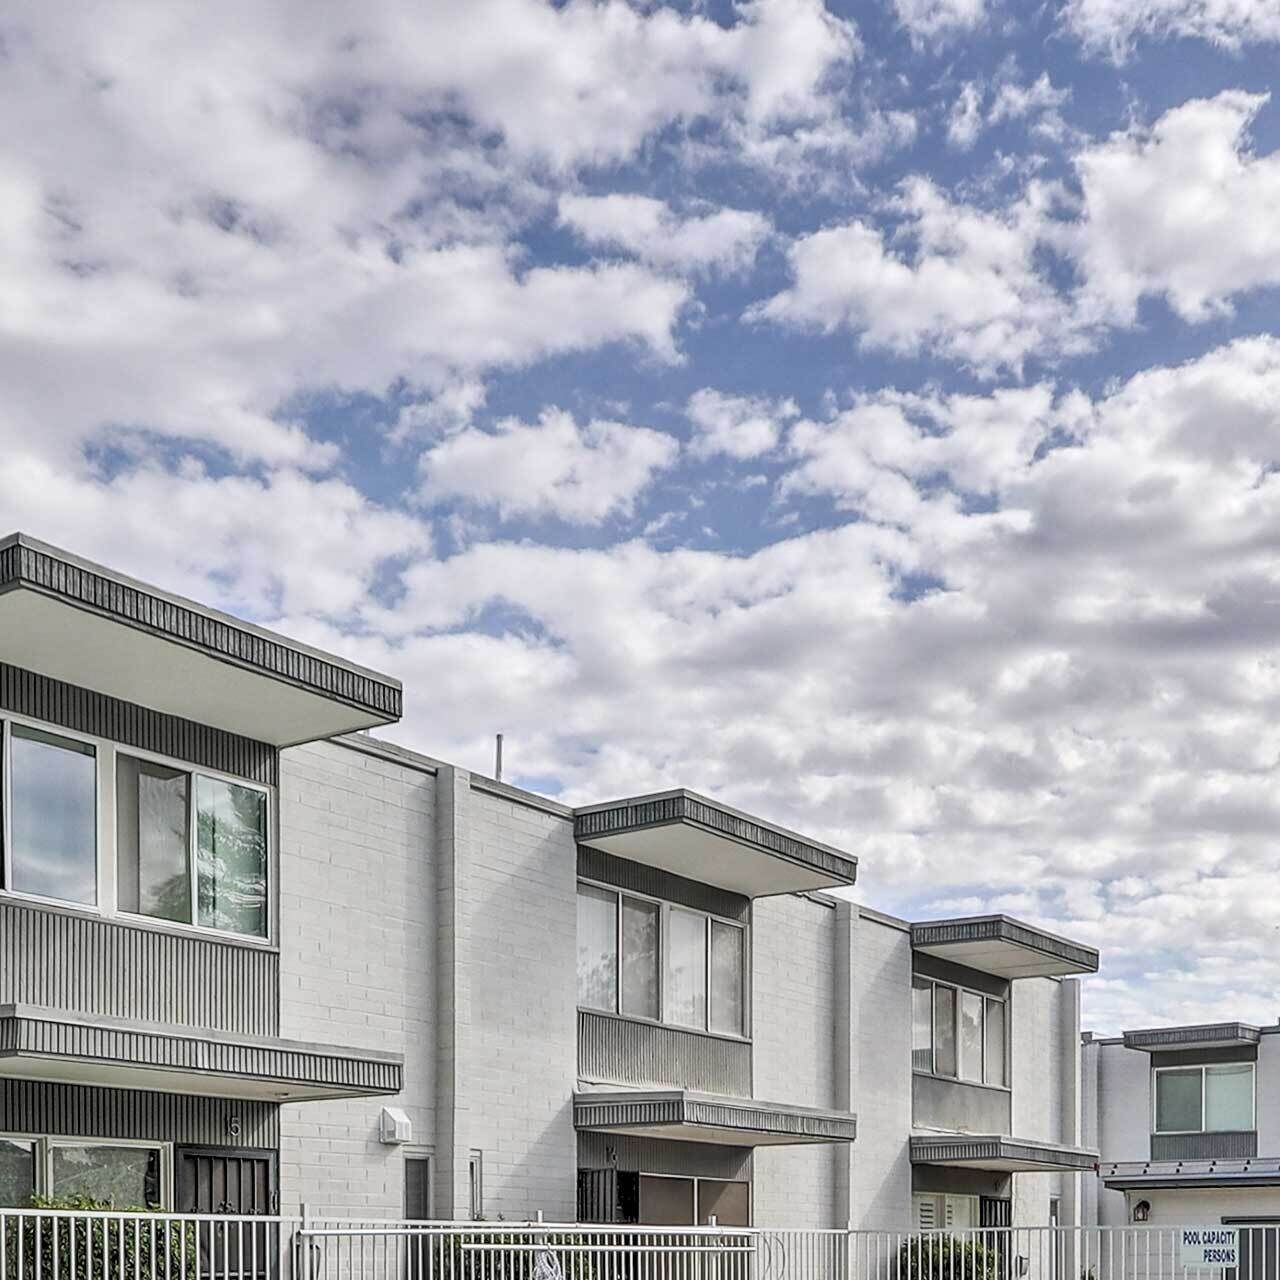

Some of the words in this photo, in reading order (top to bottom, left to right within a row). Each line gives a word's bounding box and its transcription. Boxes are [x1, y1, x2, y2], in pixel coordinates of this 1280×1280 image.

[1183, 1231, 1201, 1244] POOL
[1203, 1231, 1235, 1244] CAPACITY
[1203, 1249, 1235, 1262] PERSONS
